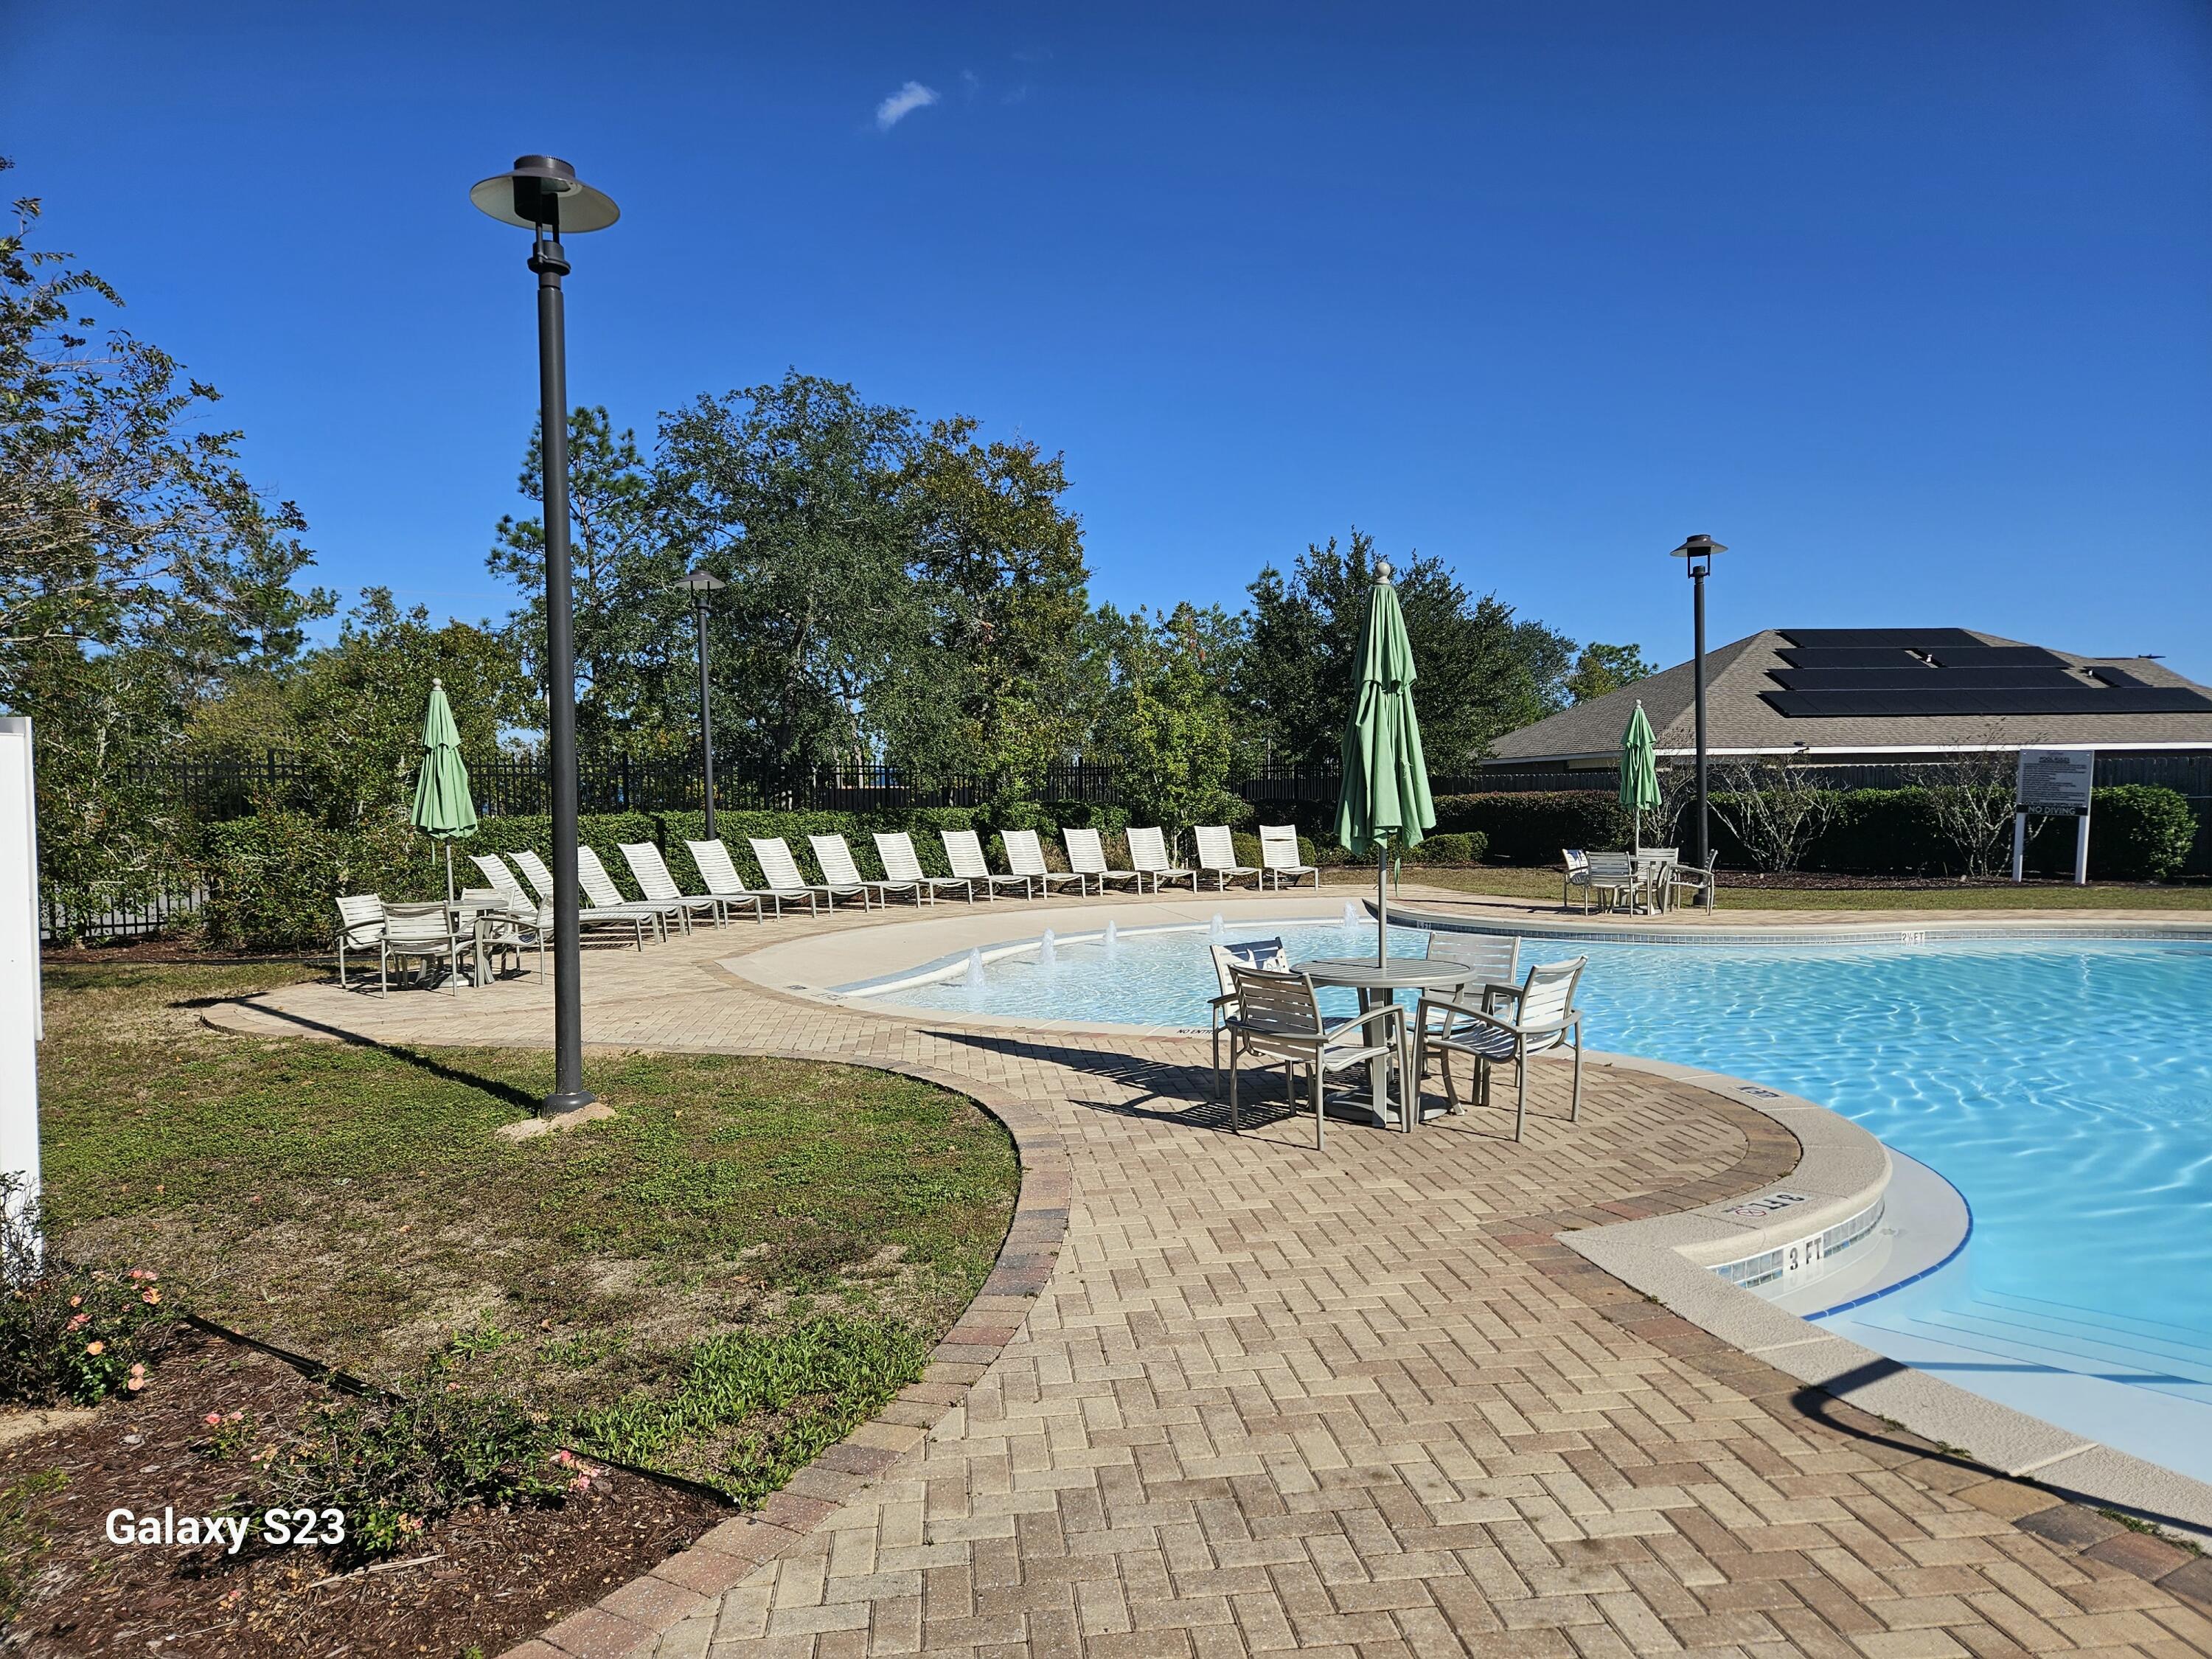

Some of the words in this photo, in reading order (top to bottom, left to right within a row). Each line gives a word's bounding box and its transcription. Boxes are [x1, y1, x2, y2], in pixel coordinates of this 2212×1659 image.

[2045, 807, 2076, 815] DIVING
[1790, 1247, 1798, 1270] 3
[1806, 1237, 1822, 1265] FT
